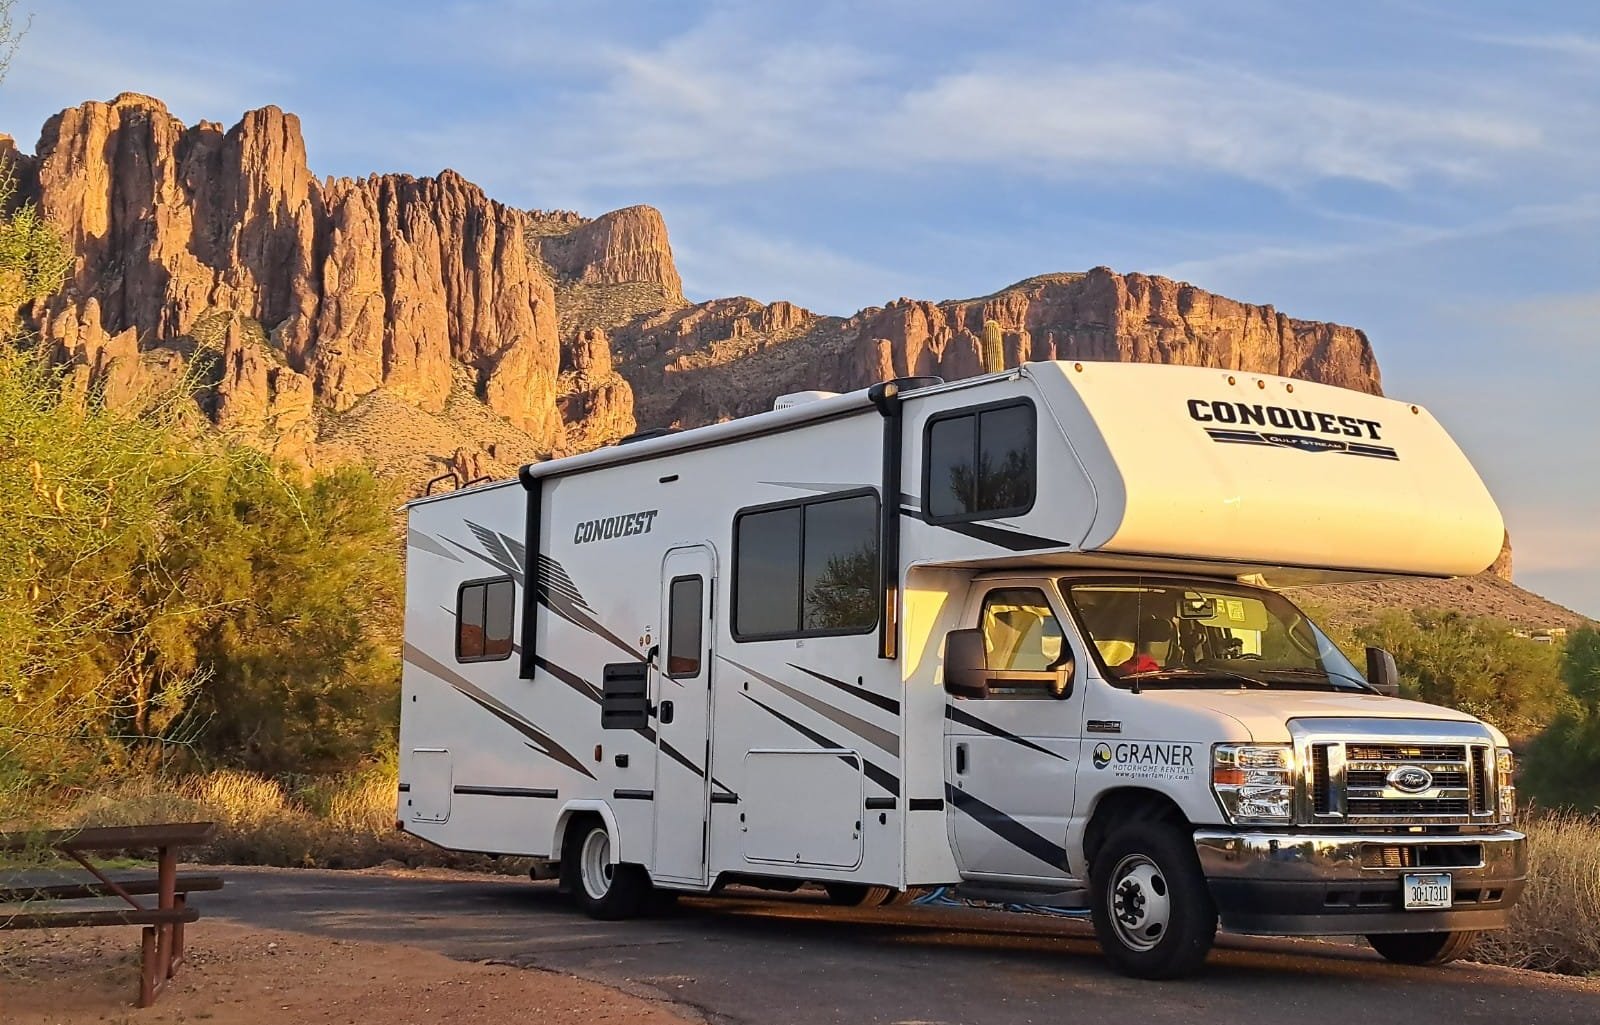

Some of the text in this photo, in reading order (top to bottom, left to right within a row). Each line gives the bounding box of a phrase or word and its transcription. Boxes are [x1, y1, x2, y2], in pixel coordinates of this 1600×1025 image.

[1187, 399, 1382, 440] CONQUEST
[1269, 436, 1342, 449] GULF STREAM
[574, 509, 658, 545] CONQUEST
[1115, 743, 1194, 767] GRANER
[1112, 764, 1195, 775] MOTORHOME RENTALS
[1405, 773, 1424, 785] Ford
